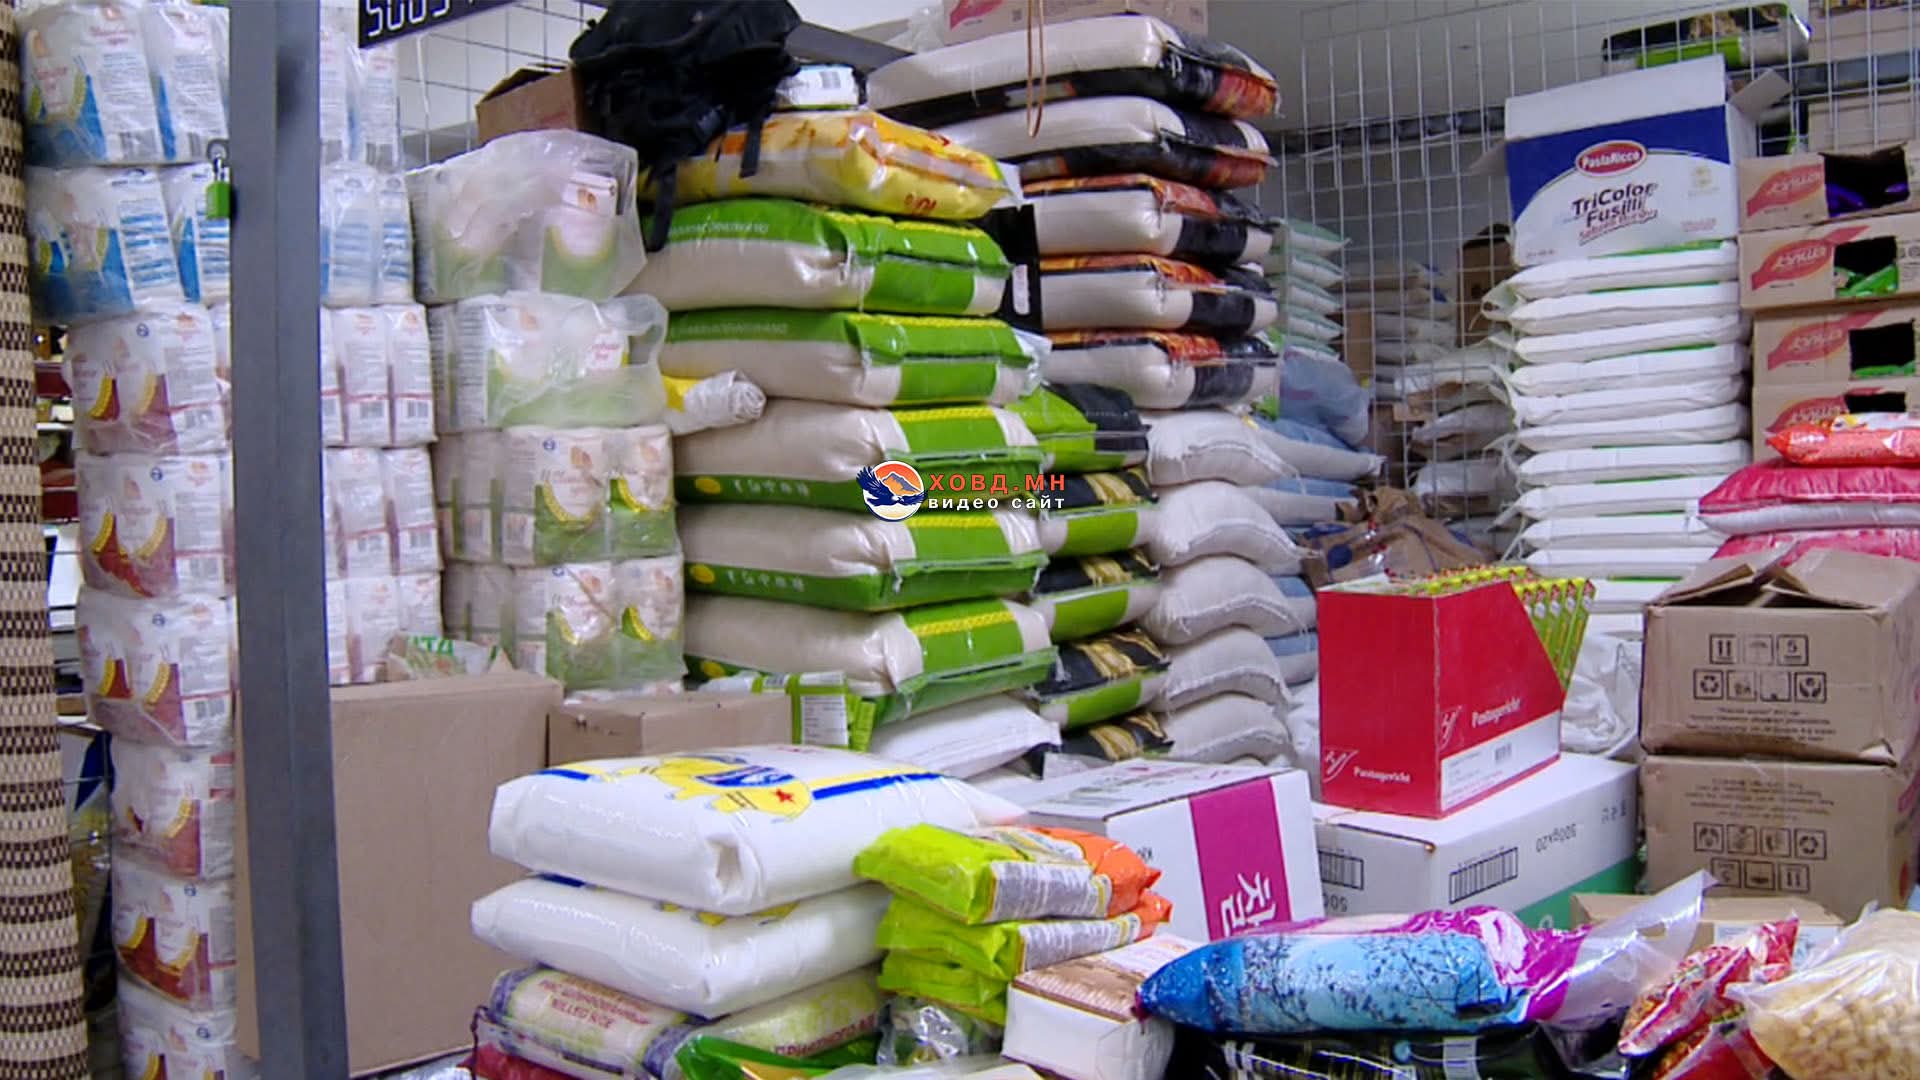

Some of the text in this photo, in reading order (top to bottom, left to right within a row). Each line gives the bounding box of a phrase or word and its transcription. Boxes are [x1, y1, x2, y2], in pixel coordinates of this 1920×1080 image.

[1573, 181, 1659, 217] TriColor
[1586, 198, 1644, 228] Fusilli
[1472, 698, 1521, 728] Pastagericht
[1354, 766, 1411, 783] Pastagericht
